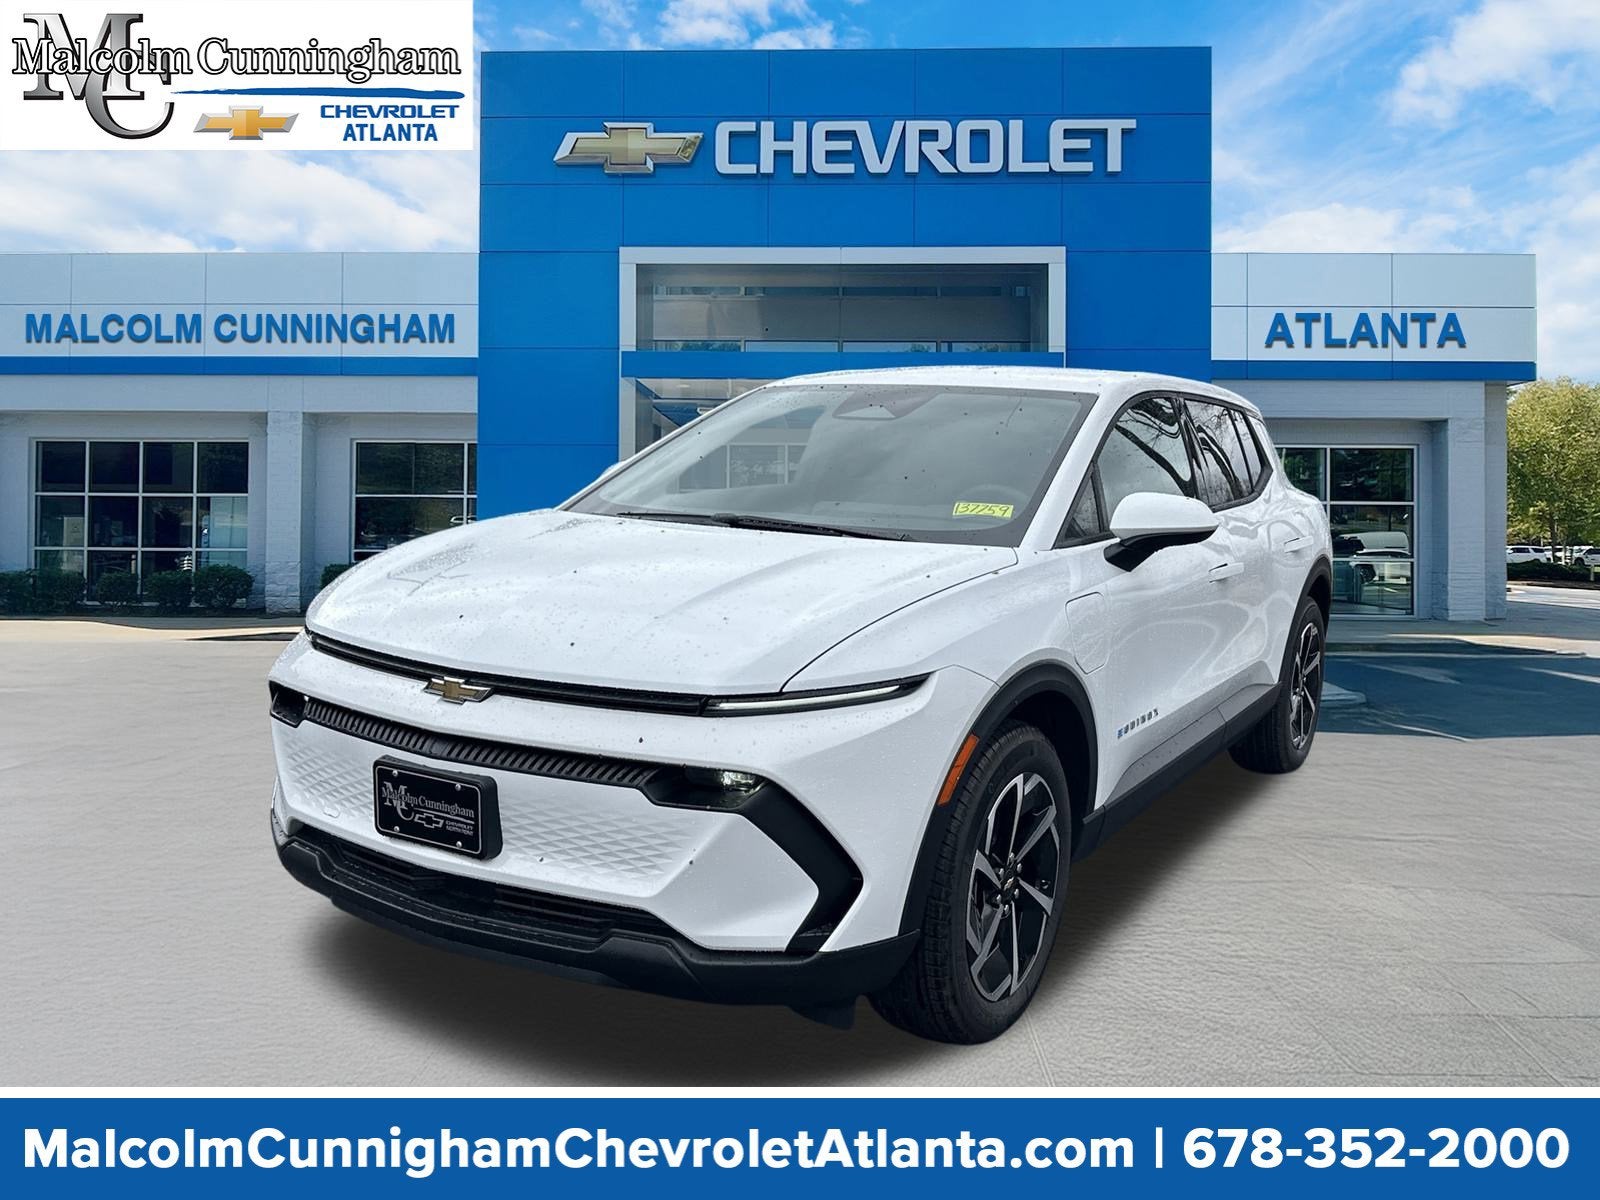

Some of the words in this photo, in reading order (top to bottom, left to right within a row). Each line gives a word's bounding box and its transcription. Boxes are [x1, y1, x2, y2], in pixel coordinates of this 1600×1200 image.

[715, 119, 1137, 174] CHEVROLET
[25, 313, 202, 343] MALCOLM
[213, 313, 456, 343] CUNNINGHAM
[1265, 312, 1467, 348] ATLANTA
[1117, 708, 1159, 740] EQUINOX
[381, 786, 418, 806] Malcolm
[418, 795, 475, 818] Cunningham
